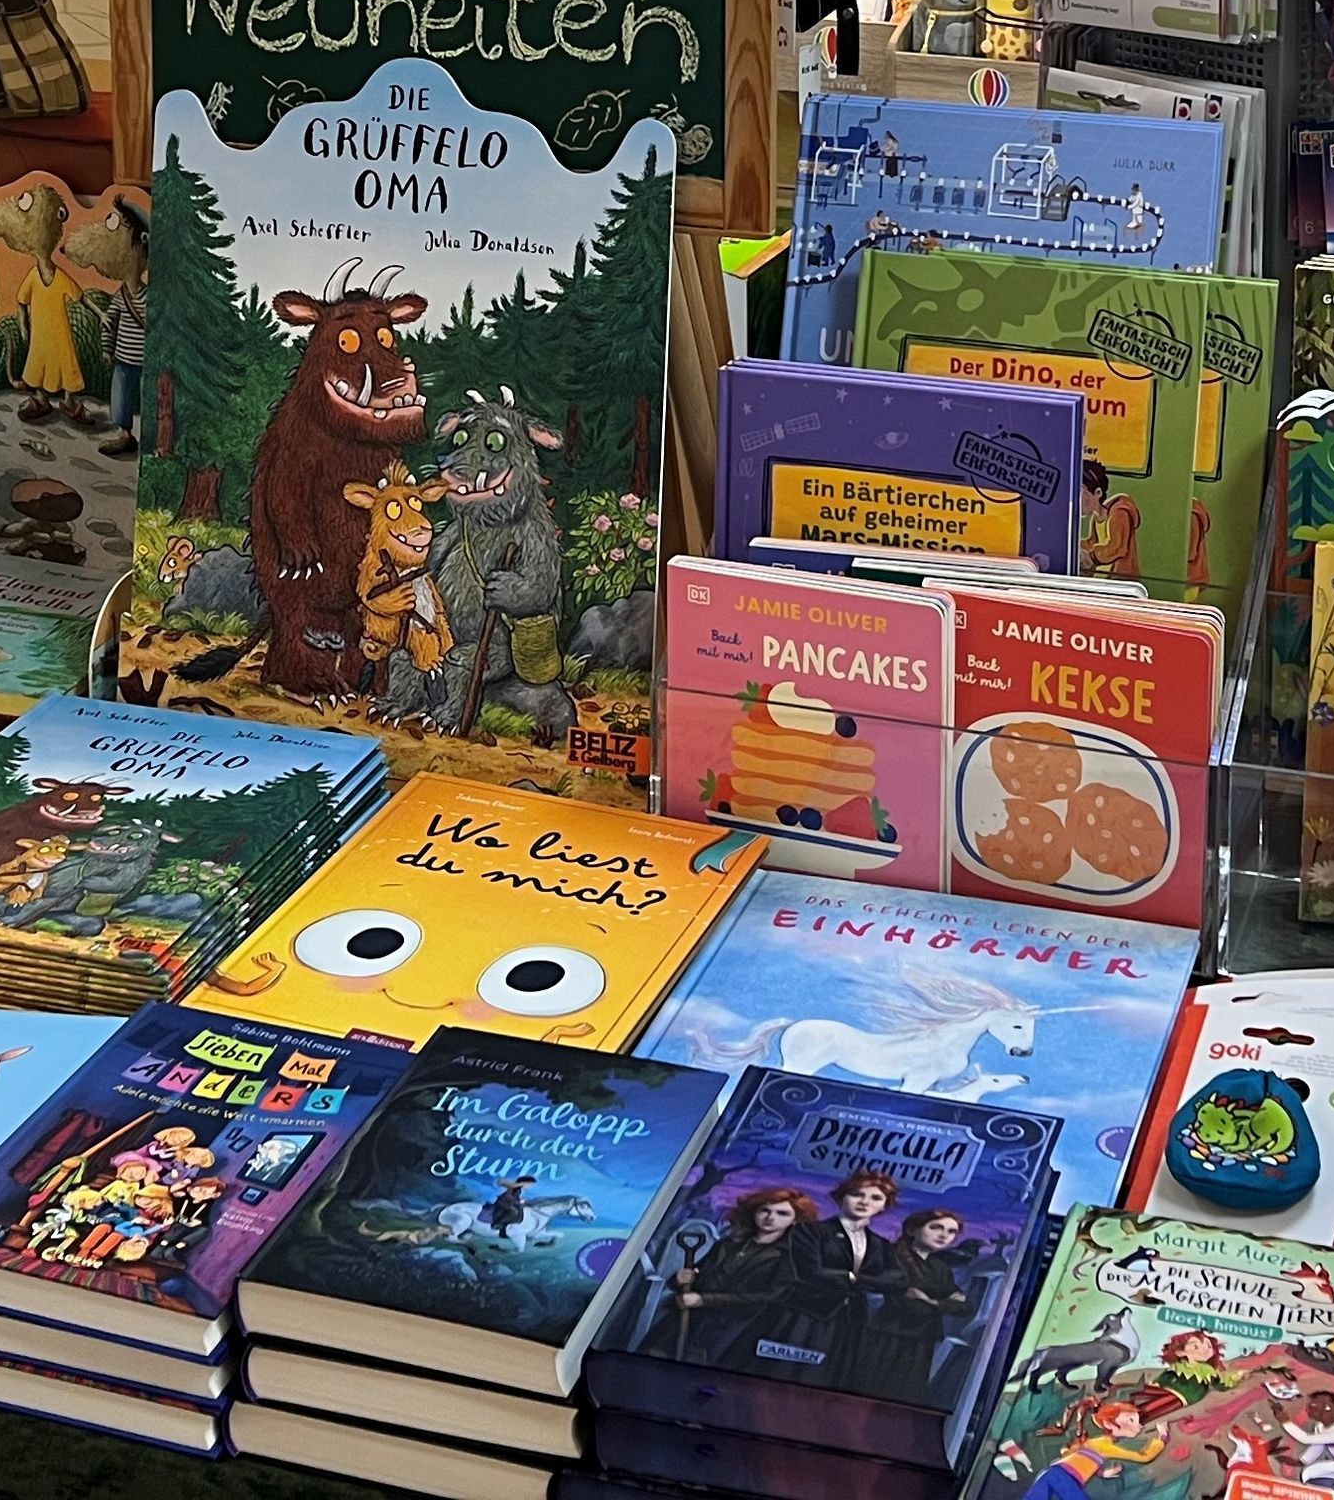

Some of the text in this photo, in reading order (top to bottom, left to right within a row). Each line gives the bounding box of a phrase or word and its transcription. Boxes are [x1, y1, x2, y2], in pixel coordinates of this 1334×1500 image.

[388, 84, 431, 111] DIE
[303, 116, 509, 170] GRÜFFELO
[354, 169, 449, 215] OMA
[241, 215, 556, 256] Axel Scheffler Julia Donaldson
[950, 355, 1106, 391] Der Dino, der
[802, 477, 987, 516] Ein Bärtierchen
[819, 503, 969, 536] auf geheimer
[47, 587, 96, 601] und
[733, 592, 889, 635] JAMIE OLIVER
[696, 642, 754, 664] mit mir!
[710, 629, 742, 646] Back
[991, 618, 1154, 665] JAMIE OLIVER
[762, 634, 928, 693] PANCAKES
[967, 654, 1001, 673] Back
[1030, 658, 1156, 724] KEKSE
[88, 735, 250, 770] GRÜFFELO
[169, 730, 207, 744] DIE
[569, 728, 637, 757] BELTZ
[109, 757, 188, 780] OMA
[426, 813, 510, 848] Wo
[529, 831, 659, 879] liest
[396, 842, 668, 916] du mich?
[805, 895, 1132, 950] DAS GEHEIME LEBEN DER
[772, 908, 1149, 979] EINHÖRNER
[231, 1022, 352, 1057] Sabine Bohlmann
[1208, 1042, 1263, 1064] goki
[452, 1055, 564, 1082] Astrid Frank
[430, 1086, 651, 1144] Im Galopp
[443, 1117, 605, 1161] durch den
[807, 1116, 969, 1171] DRACULA
[430, 1143, 567, 1181] Sturm
[1152, 1231, 1295, 1269] Margit Auer
[1106, 1272, 1132, 1284] DER
[1131, 1273, 1265, 1320] MAGISCHEN
[1168, 1266, 1280, 1300] DIE SCHULE
[758, 1342, 822, 1363] CARLSEN
